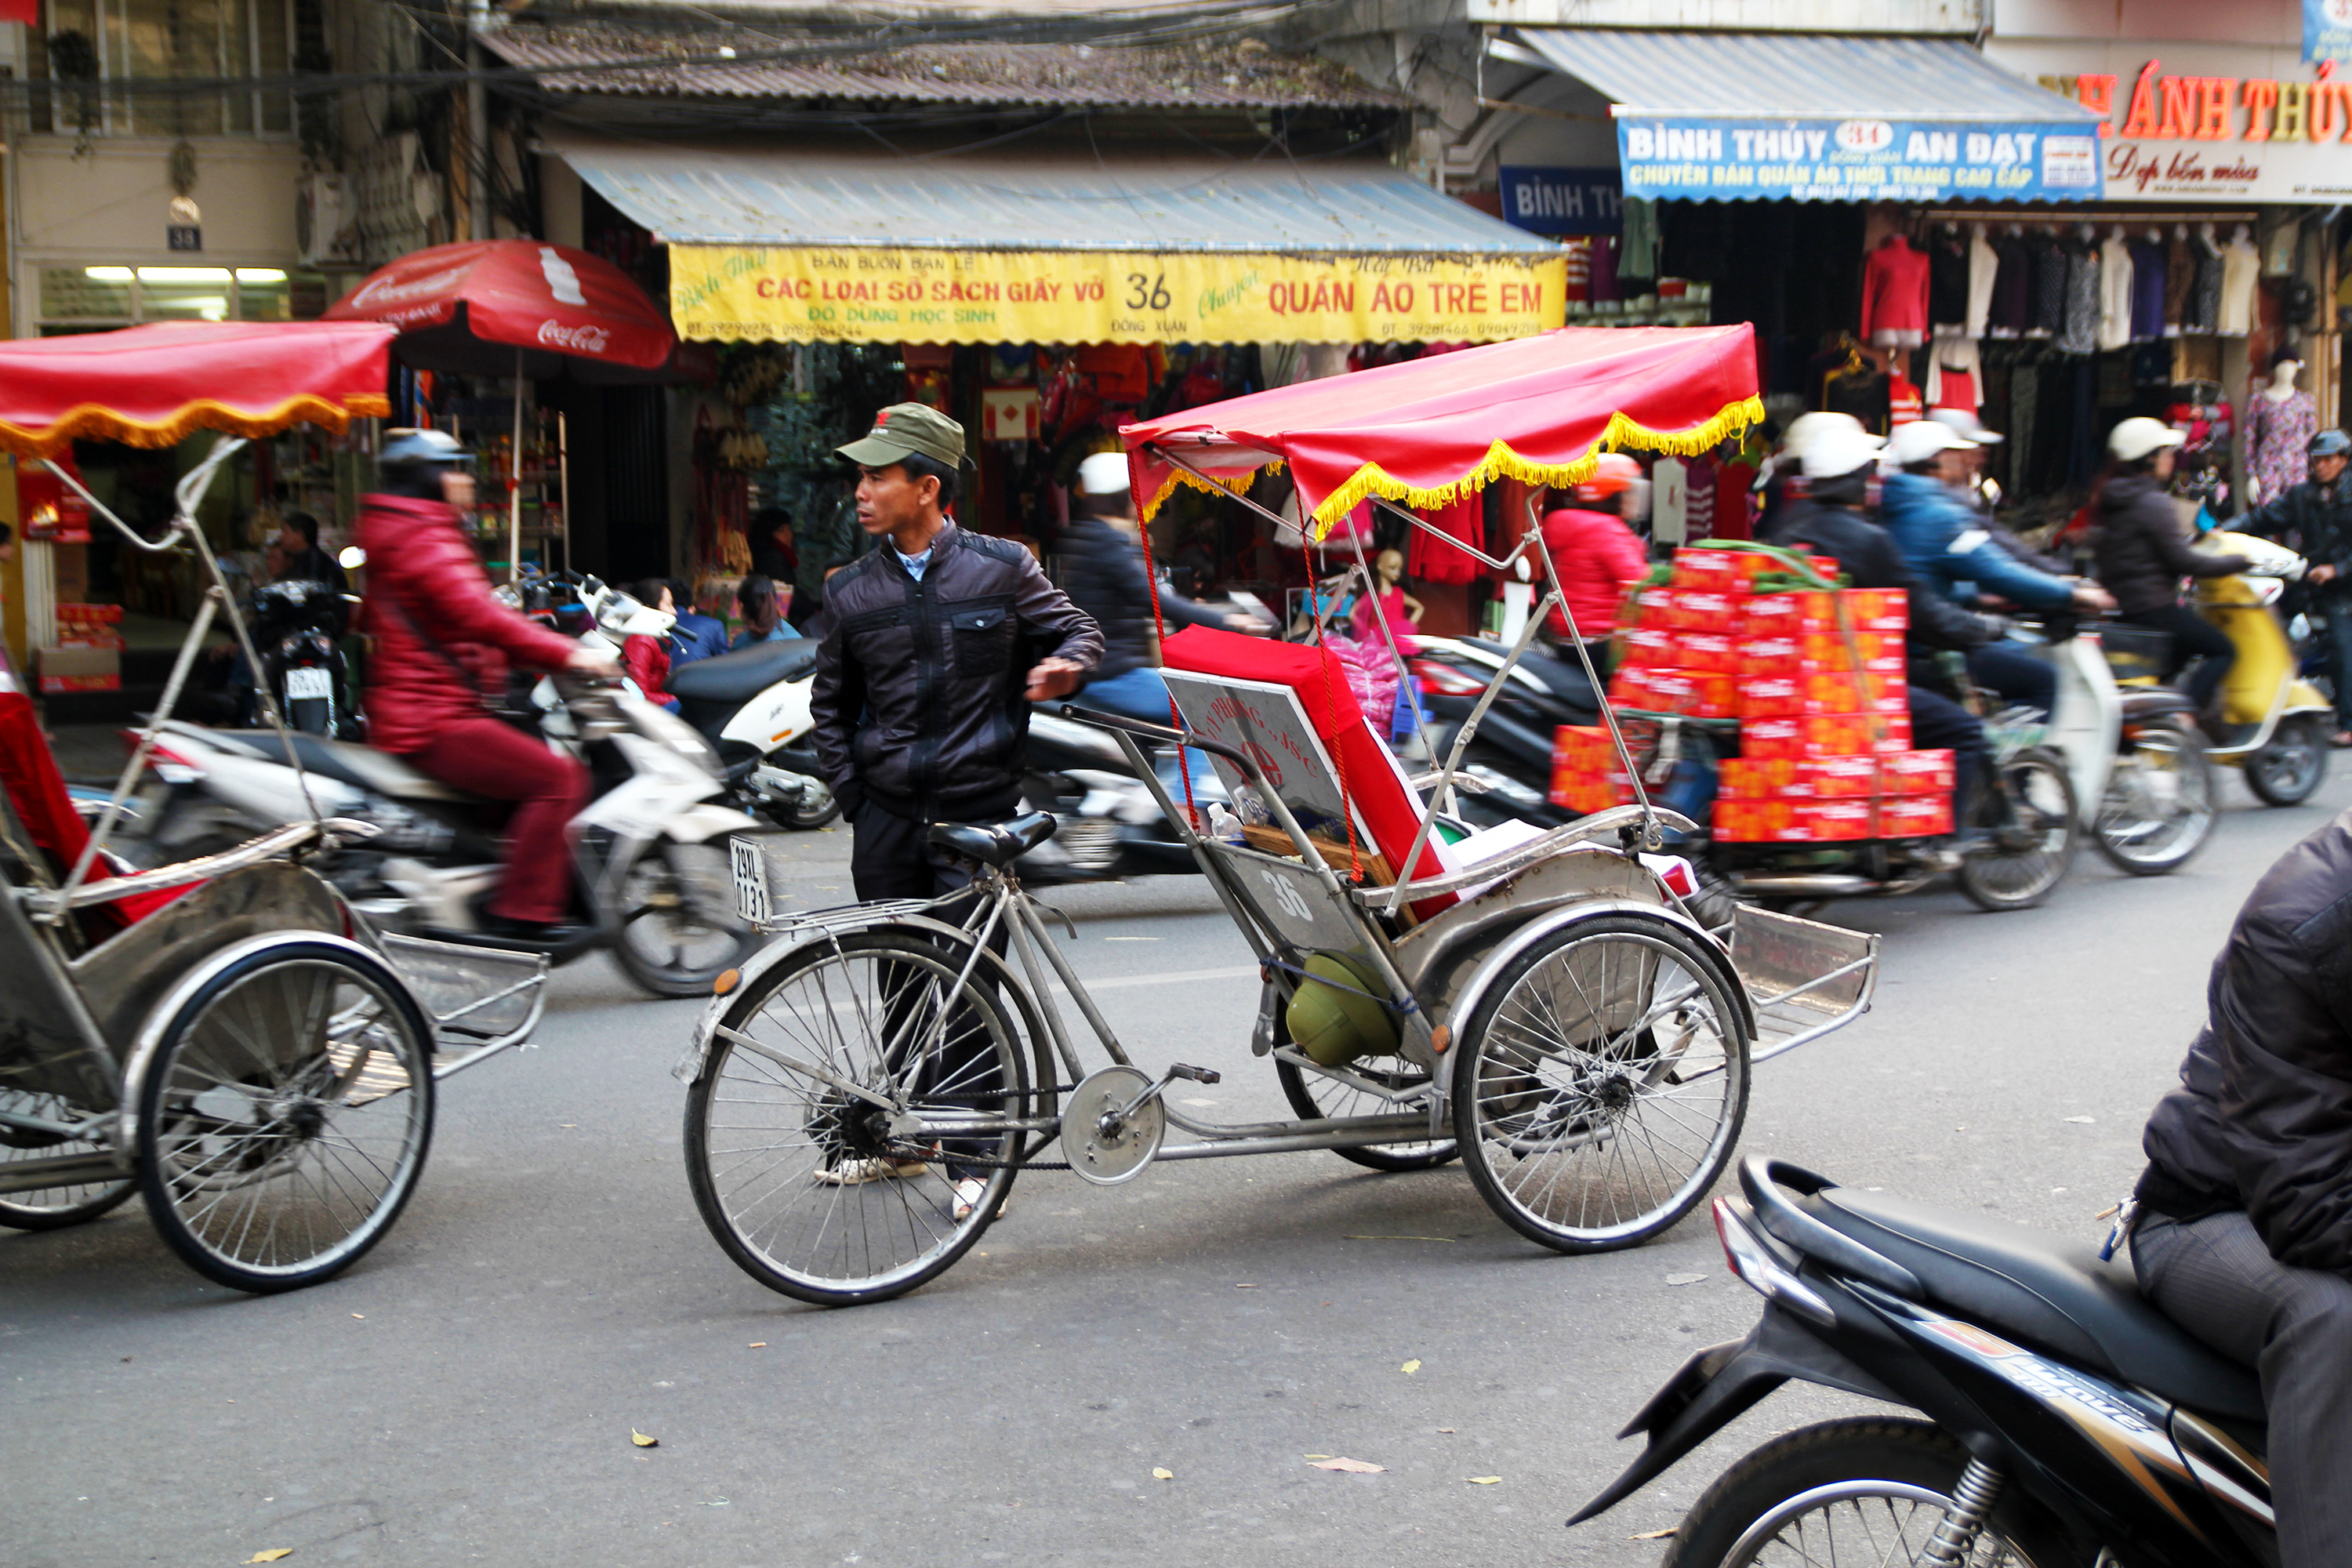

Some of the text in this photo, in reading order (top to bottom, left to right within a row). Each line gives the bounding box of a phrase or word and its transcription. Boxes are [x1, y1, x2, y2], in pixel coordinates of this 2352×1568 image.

[1627, 120, 1828, 162] BÌNH THỦY
[1906, 131, 1958, 163] AN
[1966, 132, 2038, 169] ĐẠT
[1629, 162, 1708, 187] CHUYÊN
[1712, 162, 1754, 187] BÁN
[1813, 162, 1841, 185] ÁO
[1891, 165, 1951, 188] TRANG
[1954, 167, 1993, 188] CAO
[1515, 175, 1584, 218] BÌNH
[931, 275, 1000, 302] SÁCH
[1007, 274, 1061, 302] GIẤY
[1126, 272, 1171, 310] 36
[1370, 274, 1414, 313] ÁO
[1428, 272, 1487, 313] TRẺ
[1501, 283, 1543, 313] EM
[909, 308, 946, 325] HỌC
[953, 309, 996, 322] SINH
[735, 845, 759, 883] 29XL
[737, 880, 764, 920] 0131
[1261, 869, 1313, 921] 36
